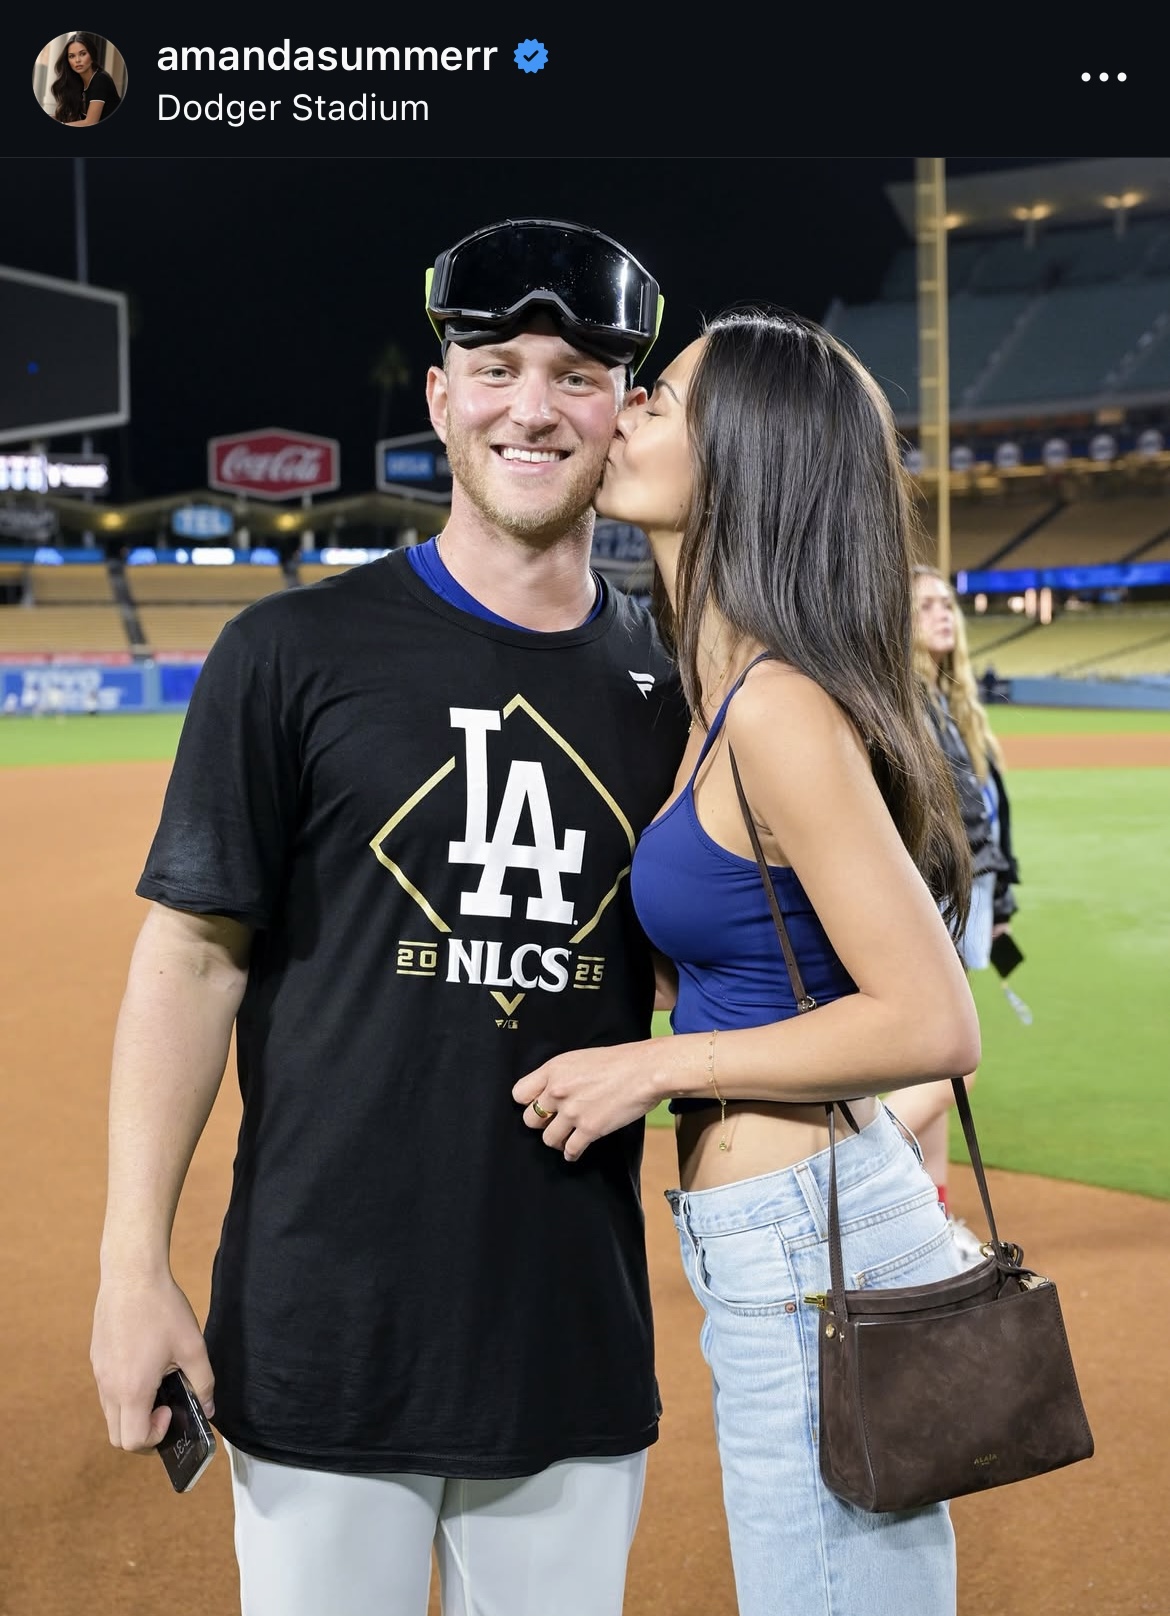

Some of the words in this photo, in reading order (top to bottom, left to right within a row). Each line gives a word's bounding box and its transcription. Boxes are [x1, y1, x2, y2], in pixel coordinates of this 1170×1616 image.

[448, 707, 586, 925] LA
[397, 949, 437, 968] 20
[446, 938, 572, 992] NLCS
[575, 963, 604, 983] 25
